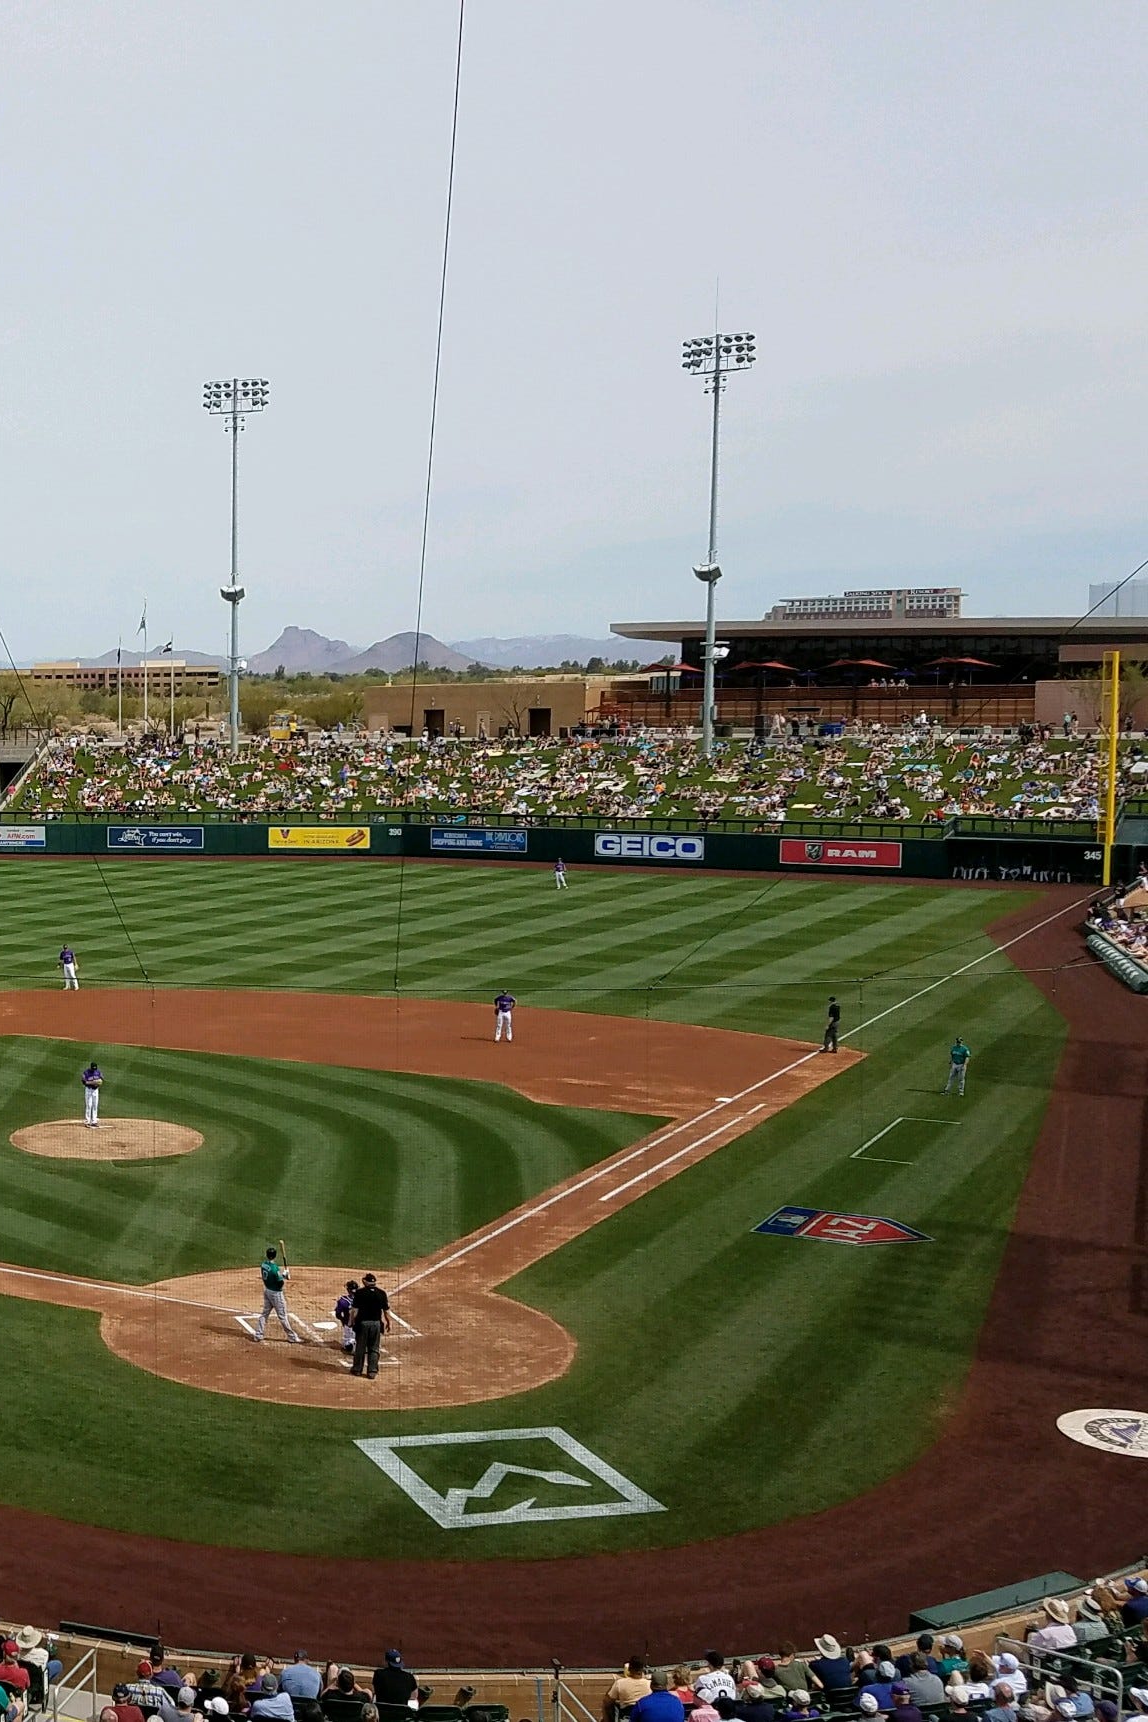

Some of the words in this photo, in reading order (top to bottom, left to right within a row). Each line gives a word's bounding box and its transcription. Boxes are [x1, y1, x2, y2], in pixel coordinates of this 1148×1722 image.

[388, 828, 403, 836] 390
[596, 835, 702, 858] GEICO
[827, 849, 877, 858] RAM
[1083, 850, 1102, 860] 345
